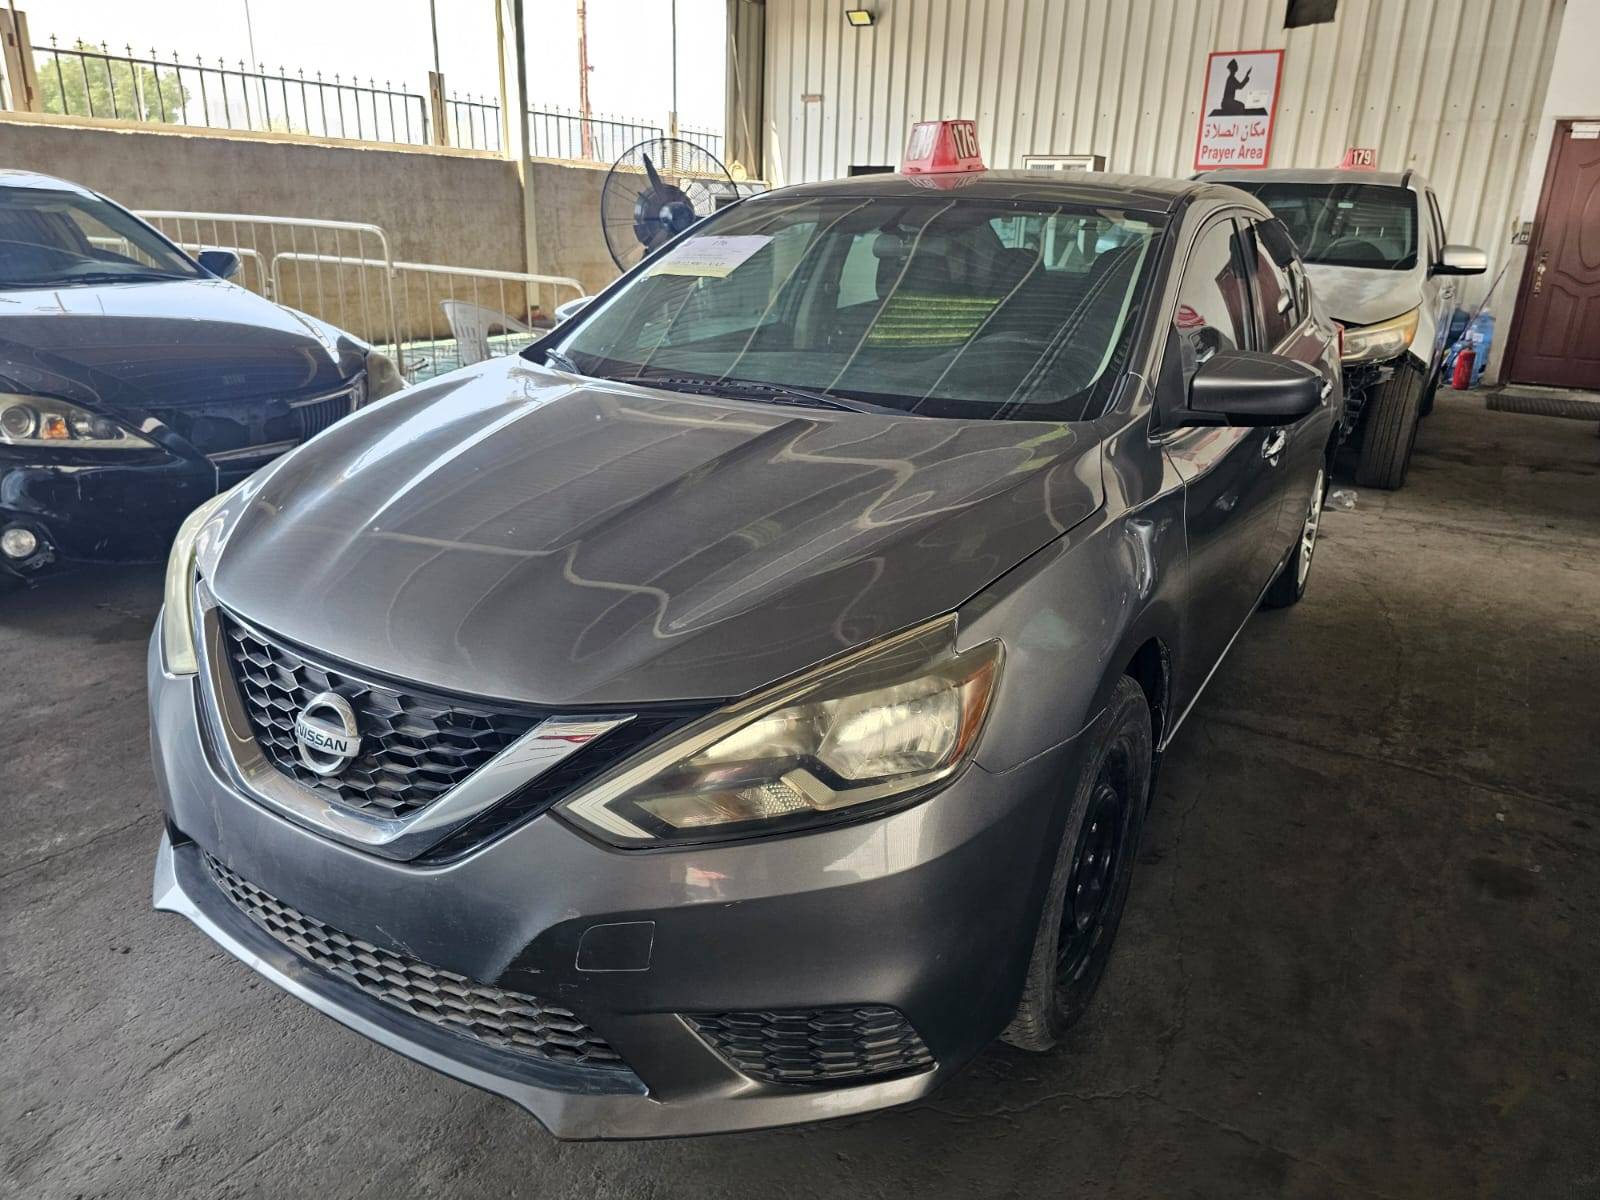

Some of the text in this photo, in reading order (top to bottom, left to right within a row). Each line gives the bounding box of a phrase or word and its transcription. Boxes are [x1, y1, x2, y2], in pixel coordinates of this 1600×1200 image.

[953, 123, 978, 159] 176
[1204, 122, 1265, 141] مكان الصلاة
[1201, 144, 1263, 163] Prayer Area
[1353, 150, 1371, 165] 179
[298, 724, 347, 752] NISSAN
